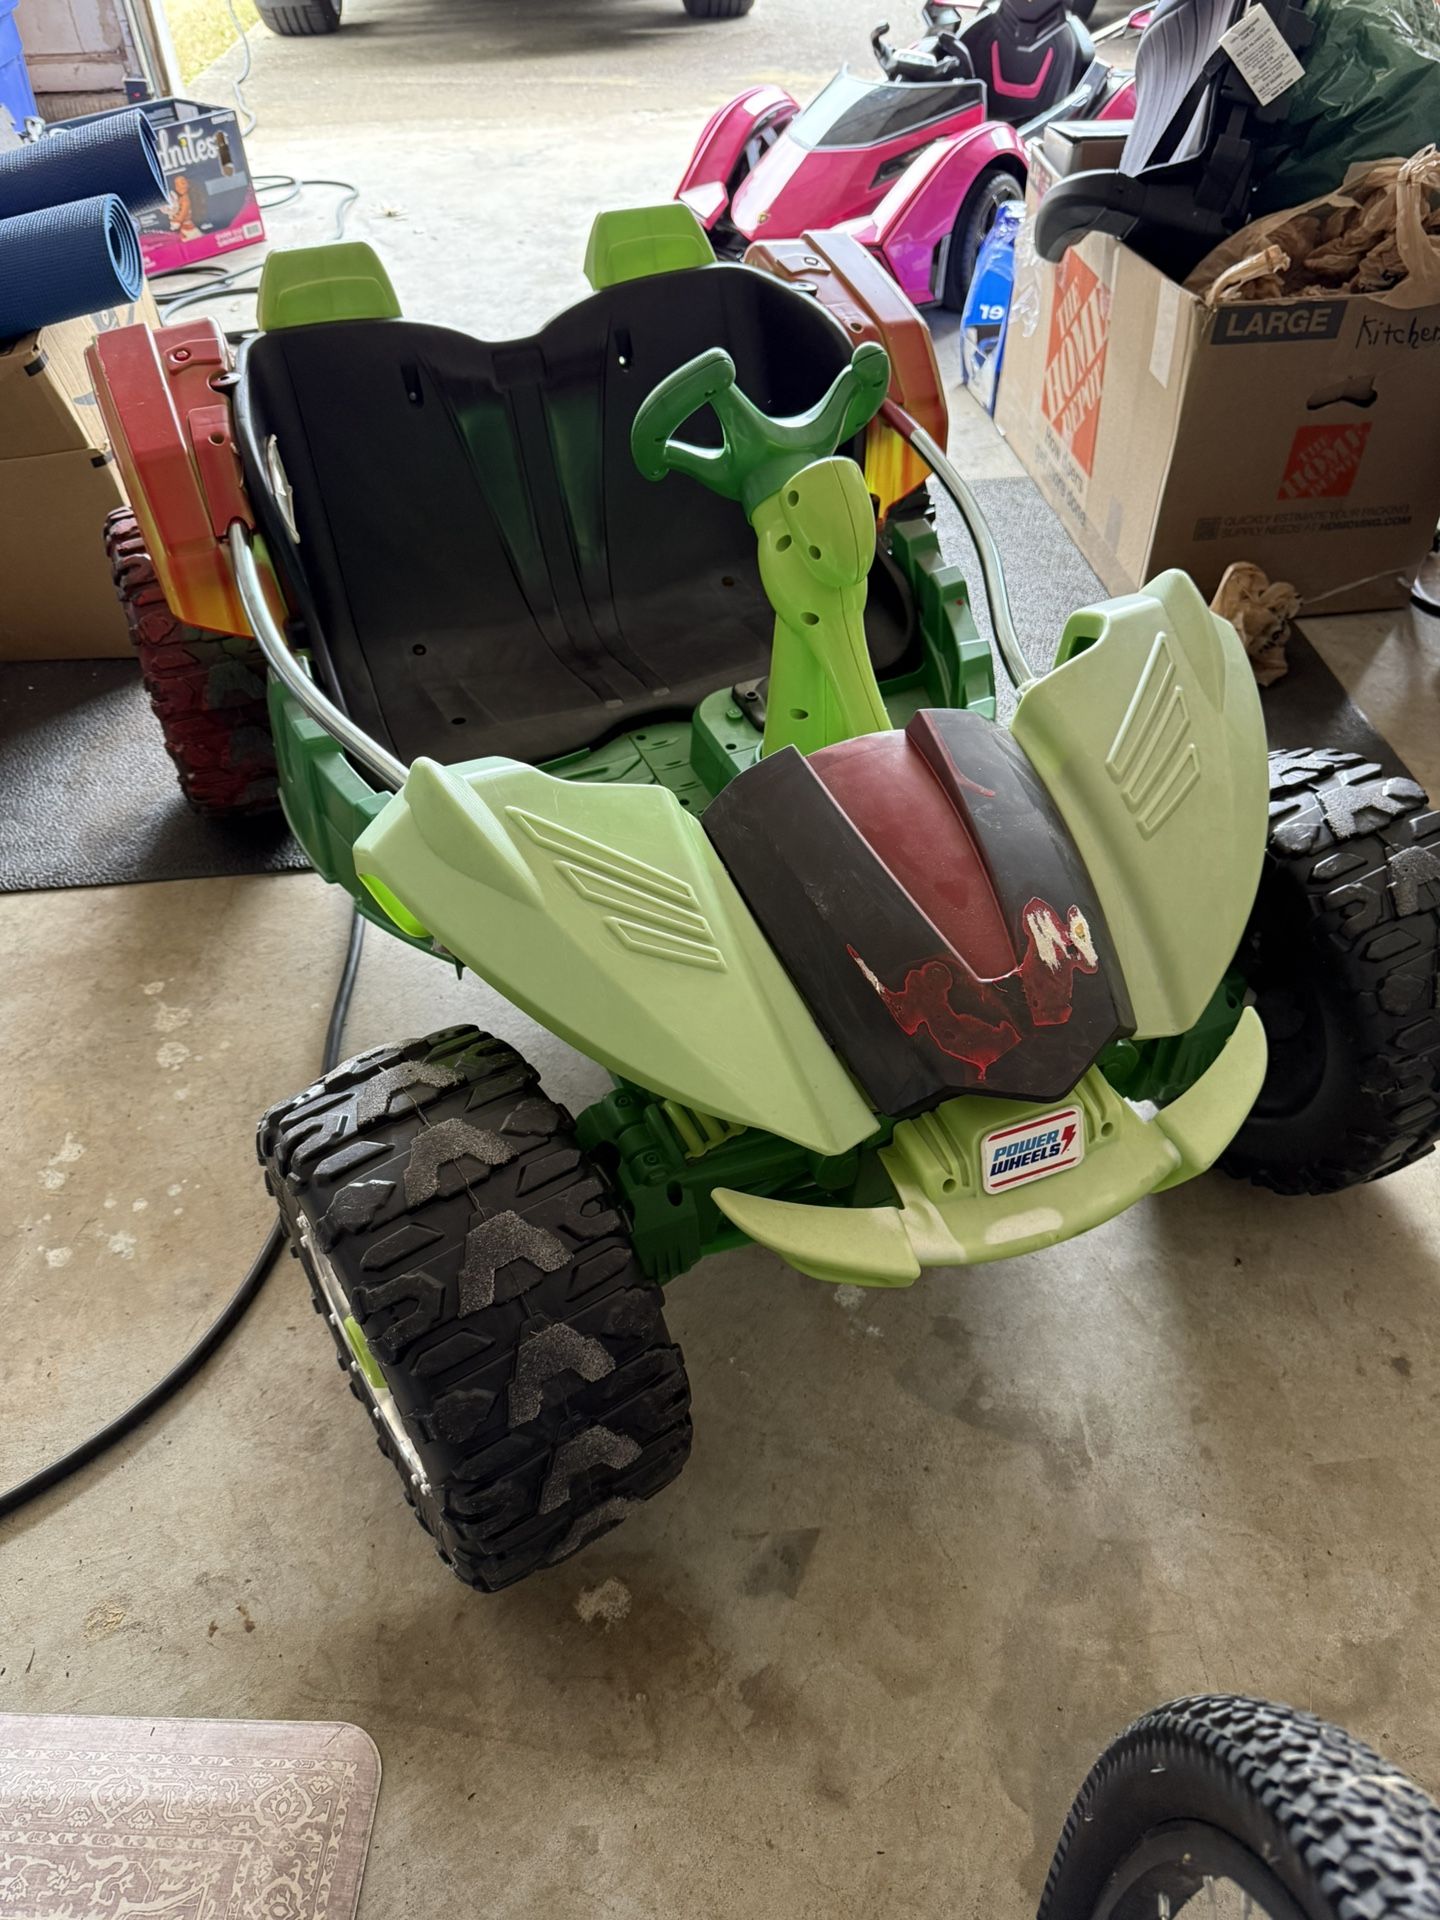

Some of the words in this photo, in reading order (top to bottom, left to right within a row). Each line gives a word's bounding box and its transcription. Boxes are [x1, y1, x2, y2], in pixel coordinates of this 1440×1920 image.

[158, 124, 220, 170] dnites
[1226, 307, 1332, 337] LARGE
[989, 1142, 1062, 1177] WHEELS
[992, 1129, 1060, 1162] POWER
